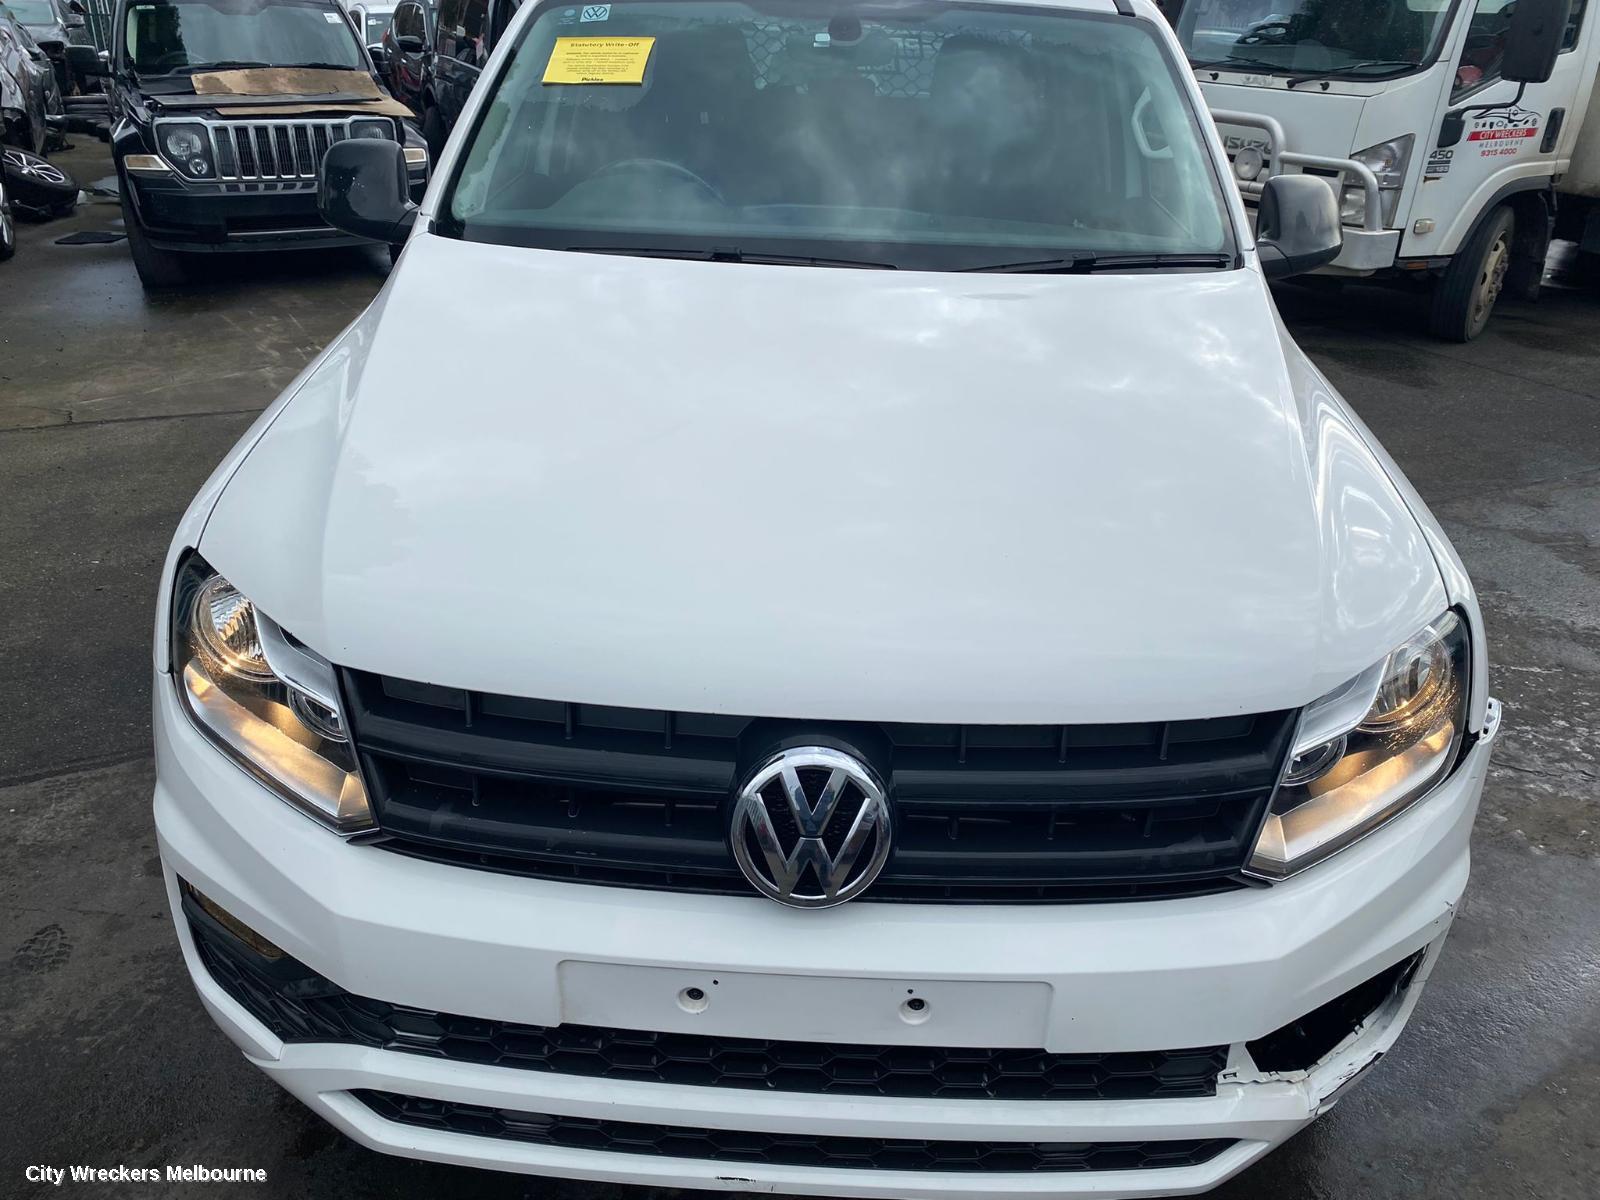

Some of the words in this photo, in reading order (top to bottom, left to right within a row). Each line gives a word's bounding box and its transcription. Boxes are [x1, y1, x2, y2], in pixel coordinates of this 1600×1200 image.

[1480, 131, 1495, 140] CITY
[1495, 128, 1527, 138] WRECKERS
[1479, 140, 1524, 148] MELBOURNE
[1429, 150, 1454, 160] 450
[1480, 149, 1499, 157] 9315
[1499, 147, 1518, 156] 4000
